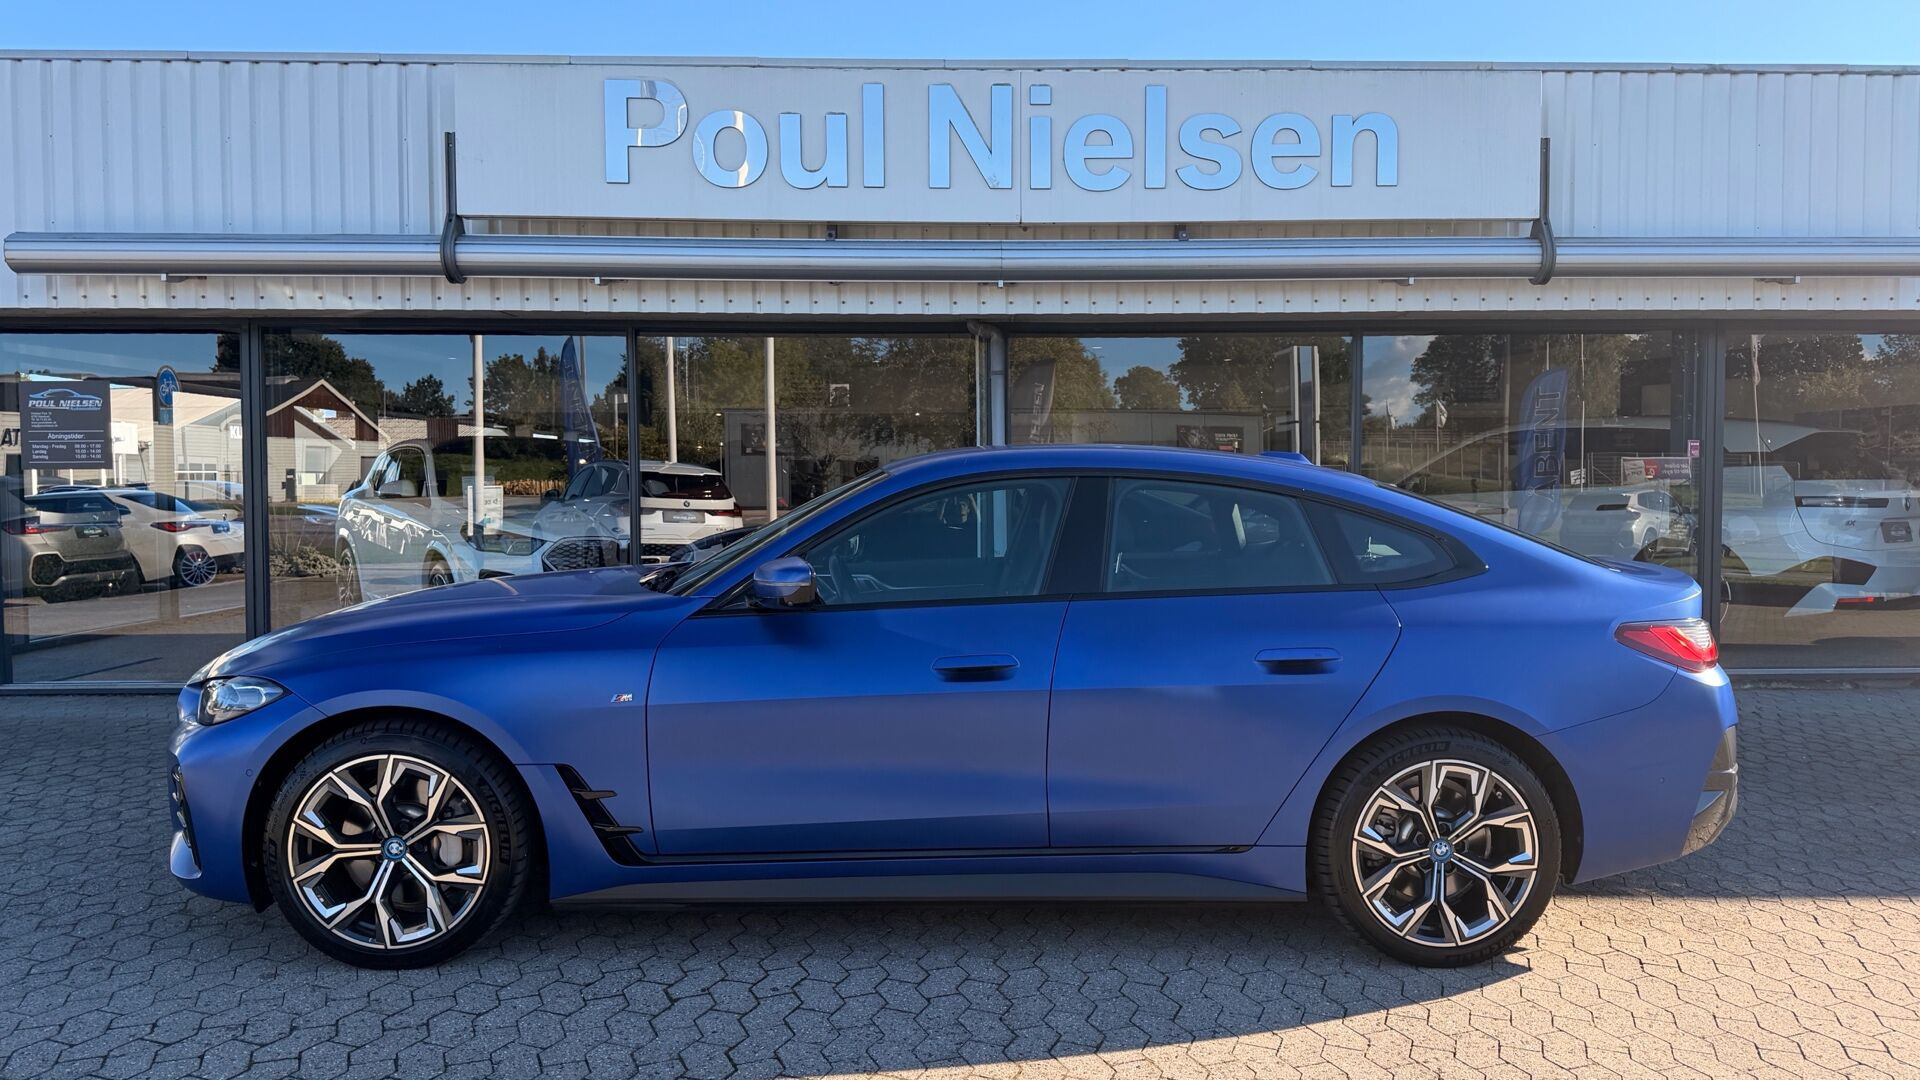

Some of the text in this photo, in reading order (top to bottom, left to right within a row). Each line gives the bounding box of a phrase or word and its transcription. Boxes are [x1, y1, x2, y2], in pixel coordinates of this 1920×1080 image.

[602, 78, 1400, 192] Poul Nielsen
[28, 399, 103, 408] POUL NIELSEN
